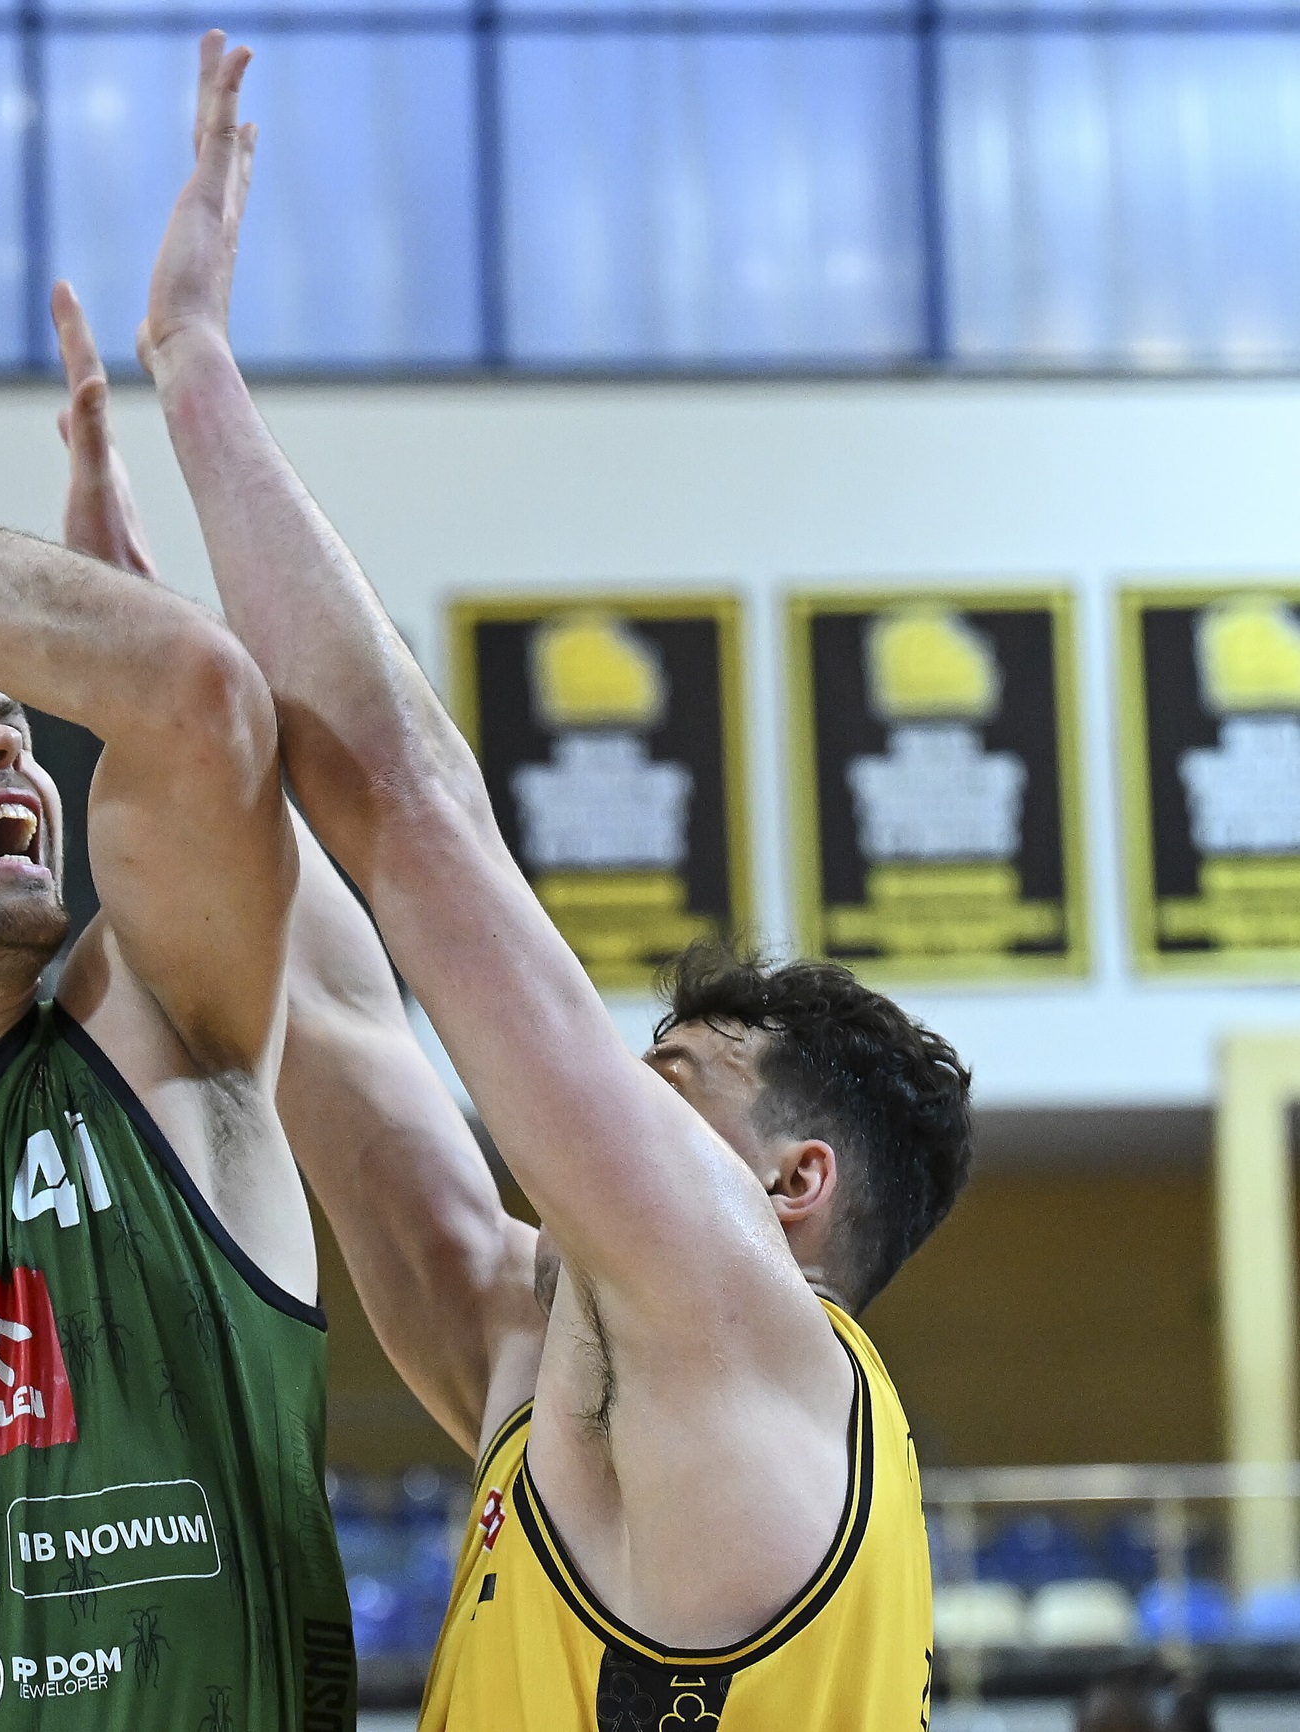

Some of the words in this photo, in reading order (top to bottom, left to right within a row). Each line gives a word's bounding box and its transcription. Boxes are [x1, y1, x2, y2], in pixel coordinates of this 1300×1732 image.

[12, 1110, 112, 1228] 41
[64, 1515, 208, 1559] NOWUM
[46, 1647, 122, 1681] DOM
[20, 1674, 109, 1699] EWELOPER
